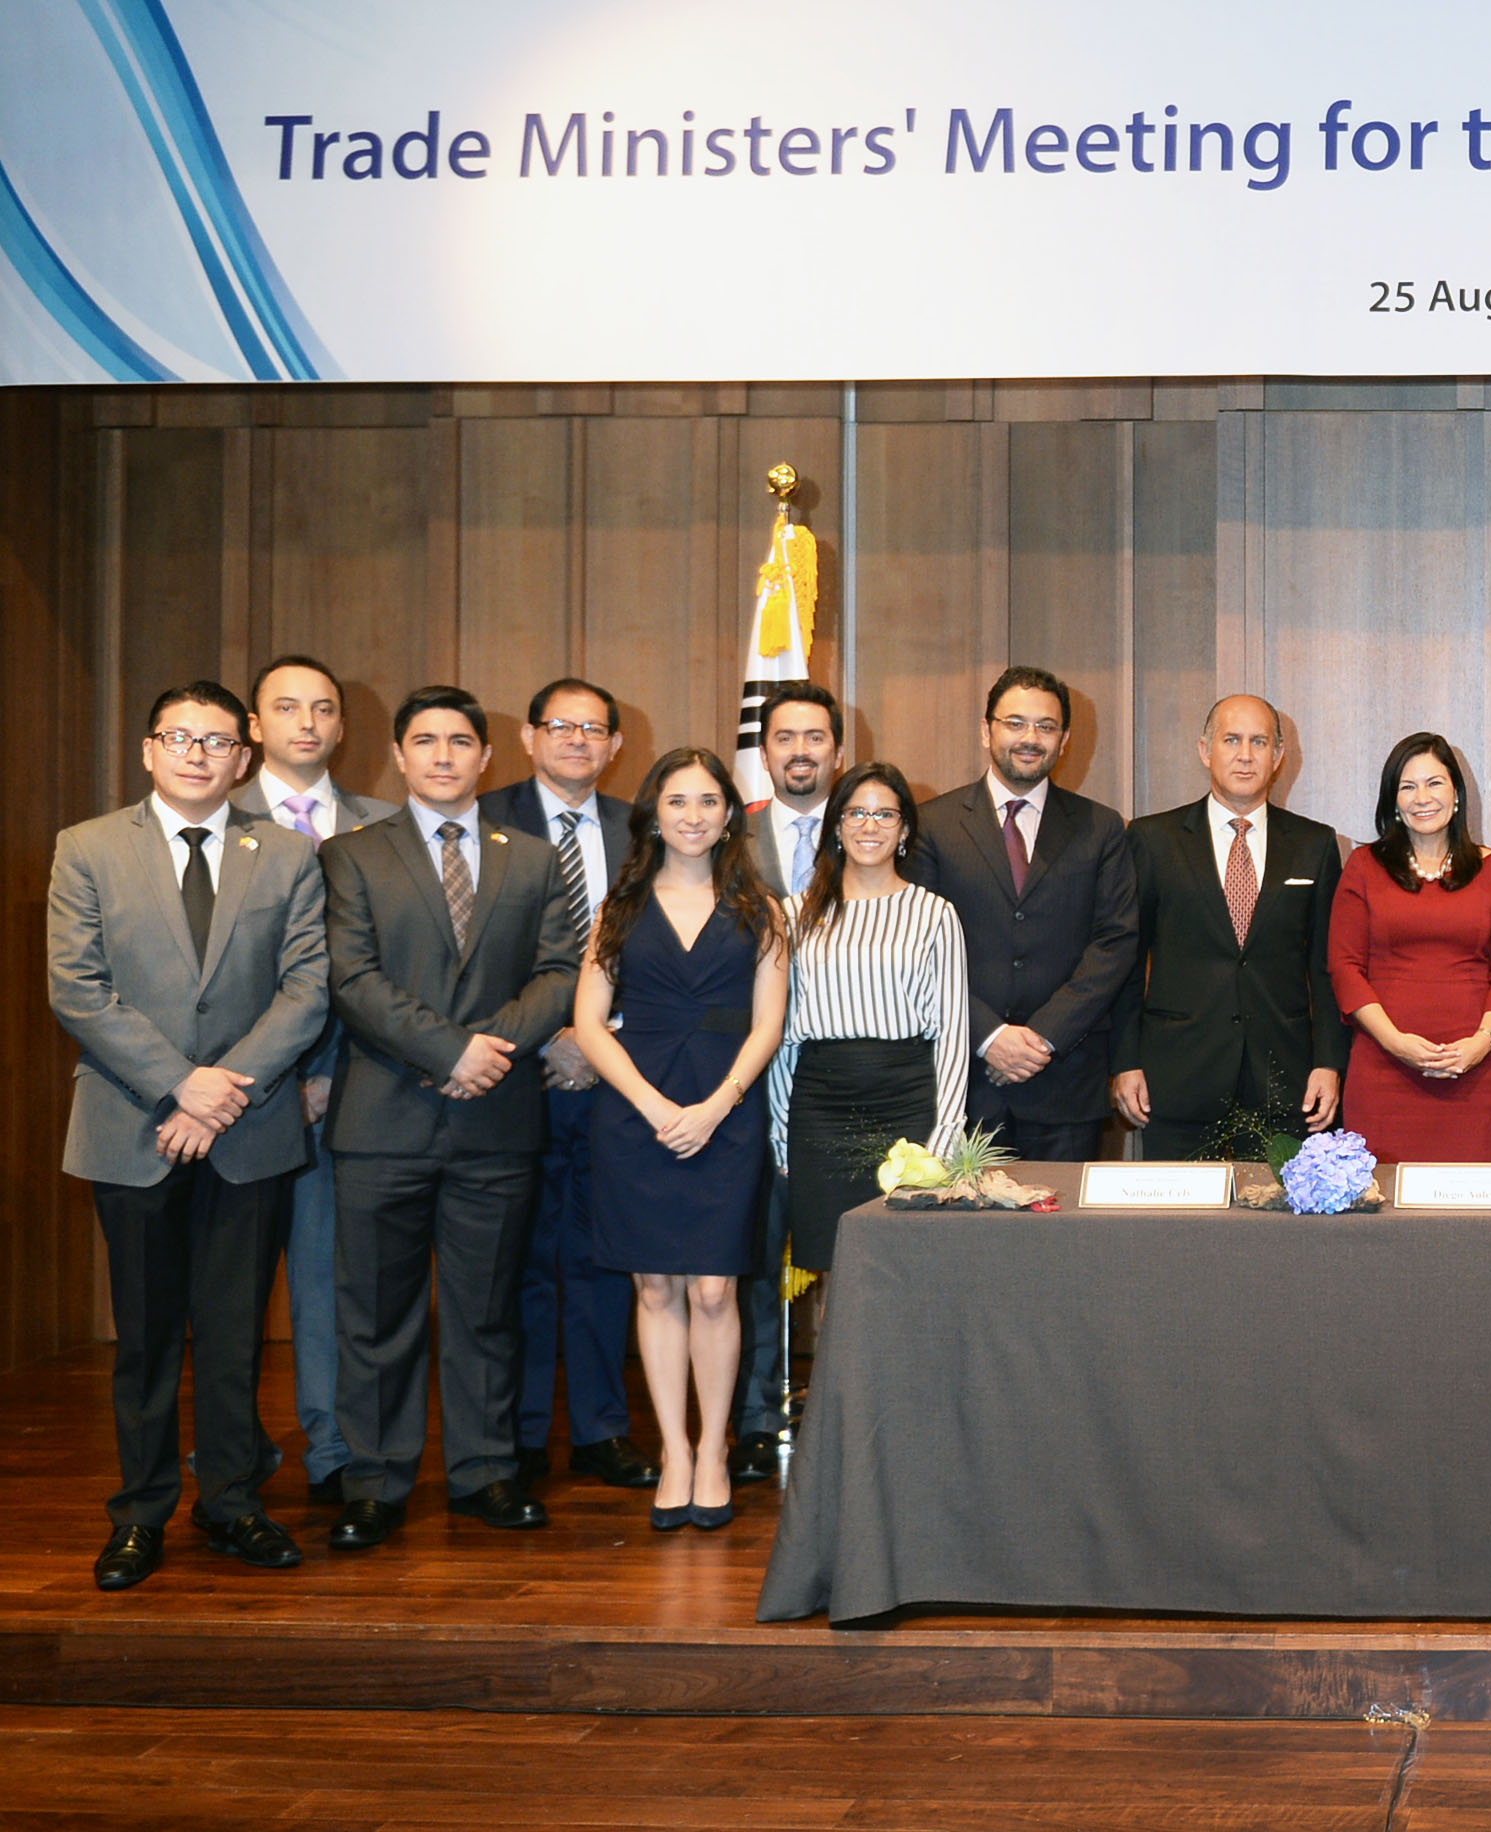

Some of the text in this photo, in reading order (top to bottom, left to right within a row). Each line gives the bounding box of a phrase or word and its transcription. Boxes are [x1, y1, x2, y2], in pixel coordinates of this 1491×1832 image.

[264, 109, 490, 181] Trade
[519, 107, 916, 178] Ministers'
[945, 103, 1291, 192] Meeting
[1318, 99, 1439, 171] for
[1369, 281, 1415, 313] 25
